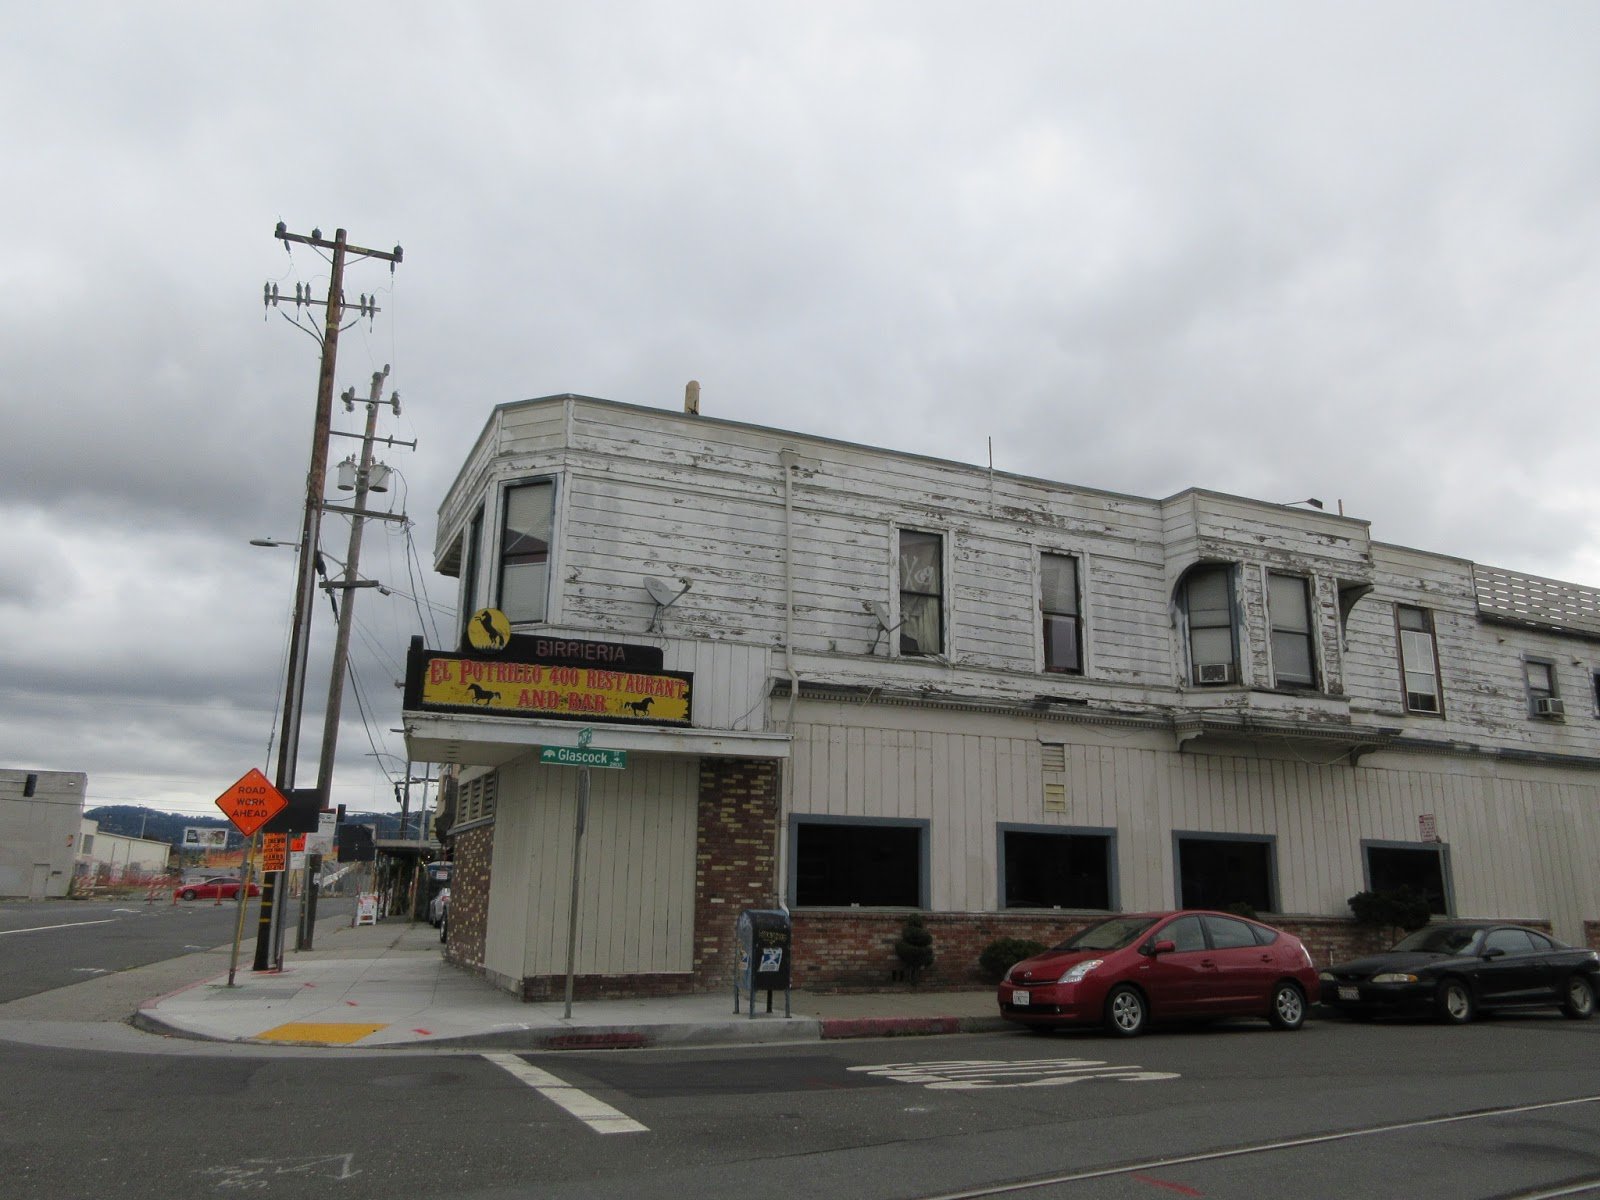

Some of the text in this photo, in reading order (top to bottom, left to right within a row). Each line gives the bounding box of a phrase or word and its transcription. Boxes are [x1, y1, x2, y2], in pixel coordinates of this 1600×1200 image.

[536, 640, 626, 662] BIRRIERIA
[458, 661, 543, 685] POTRILLO
[549, 667, 579, 686] 400
[587, 669, 688, 699] RESTAURANT
[517, 689, 608, 713] AND BAR
[558, 748, 608, 764] Glascock
[238, 786, 266, 794] ROAD
[236, 798, 265, 806] WORK
[232, 809, 268, 817] AHEAD
